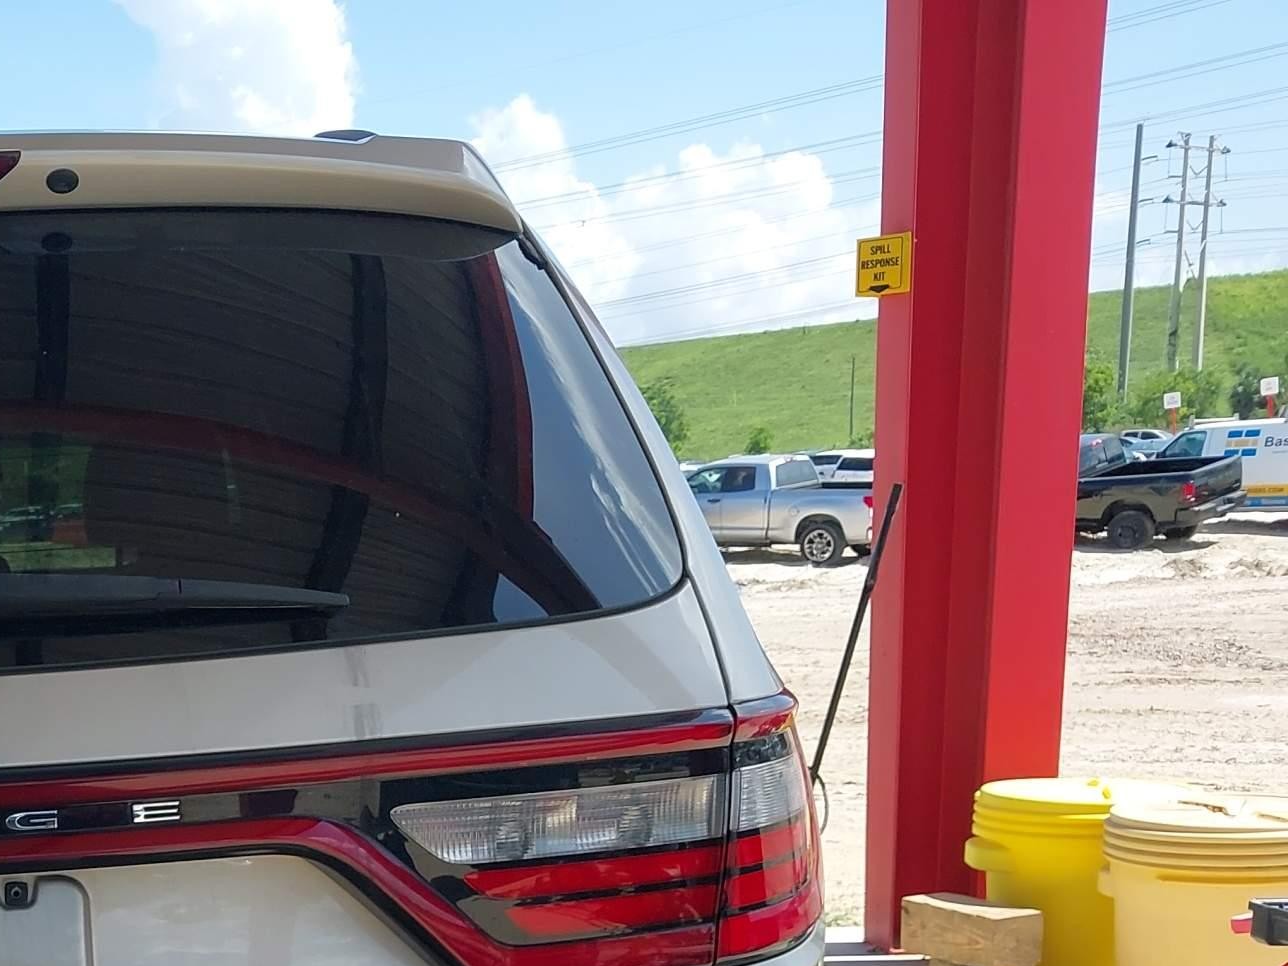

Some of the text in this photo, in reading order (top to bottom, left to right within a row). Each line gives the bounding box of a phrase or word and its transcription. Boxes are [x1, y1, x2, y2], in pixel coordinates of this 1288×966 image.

[870, 244, 891, 255] SPILL
[861, 256, 899, 270] RESPONSE
[873, 271, 885, 281] KIT
